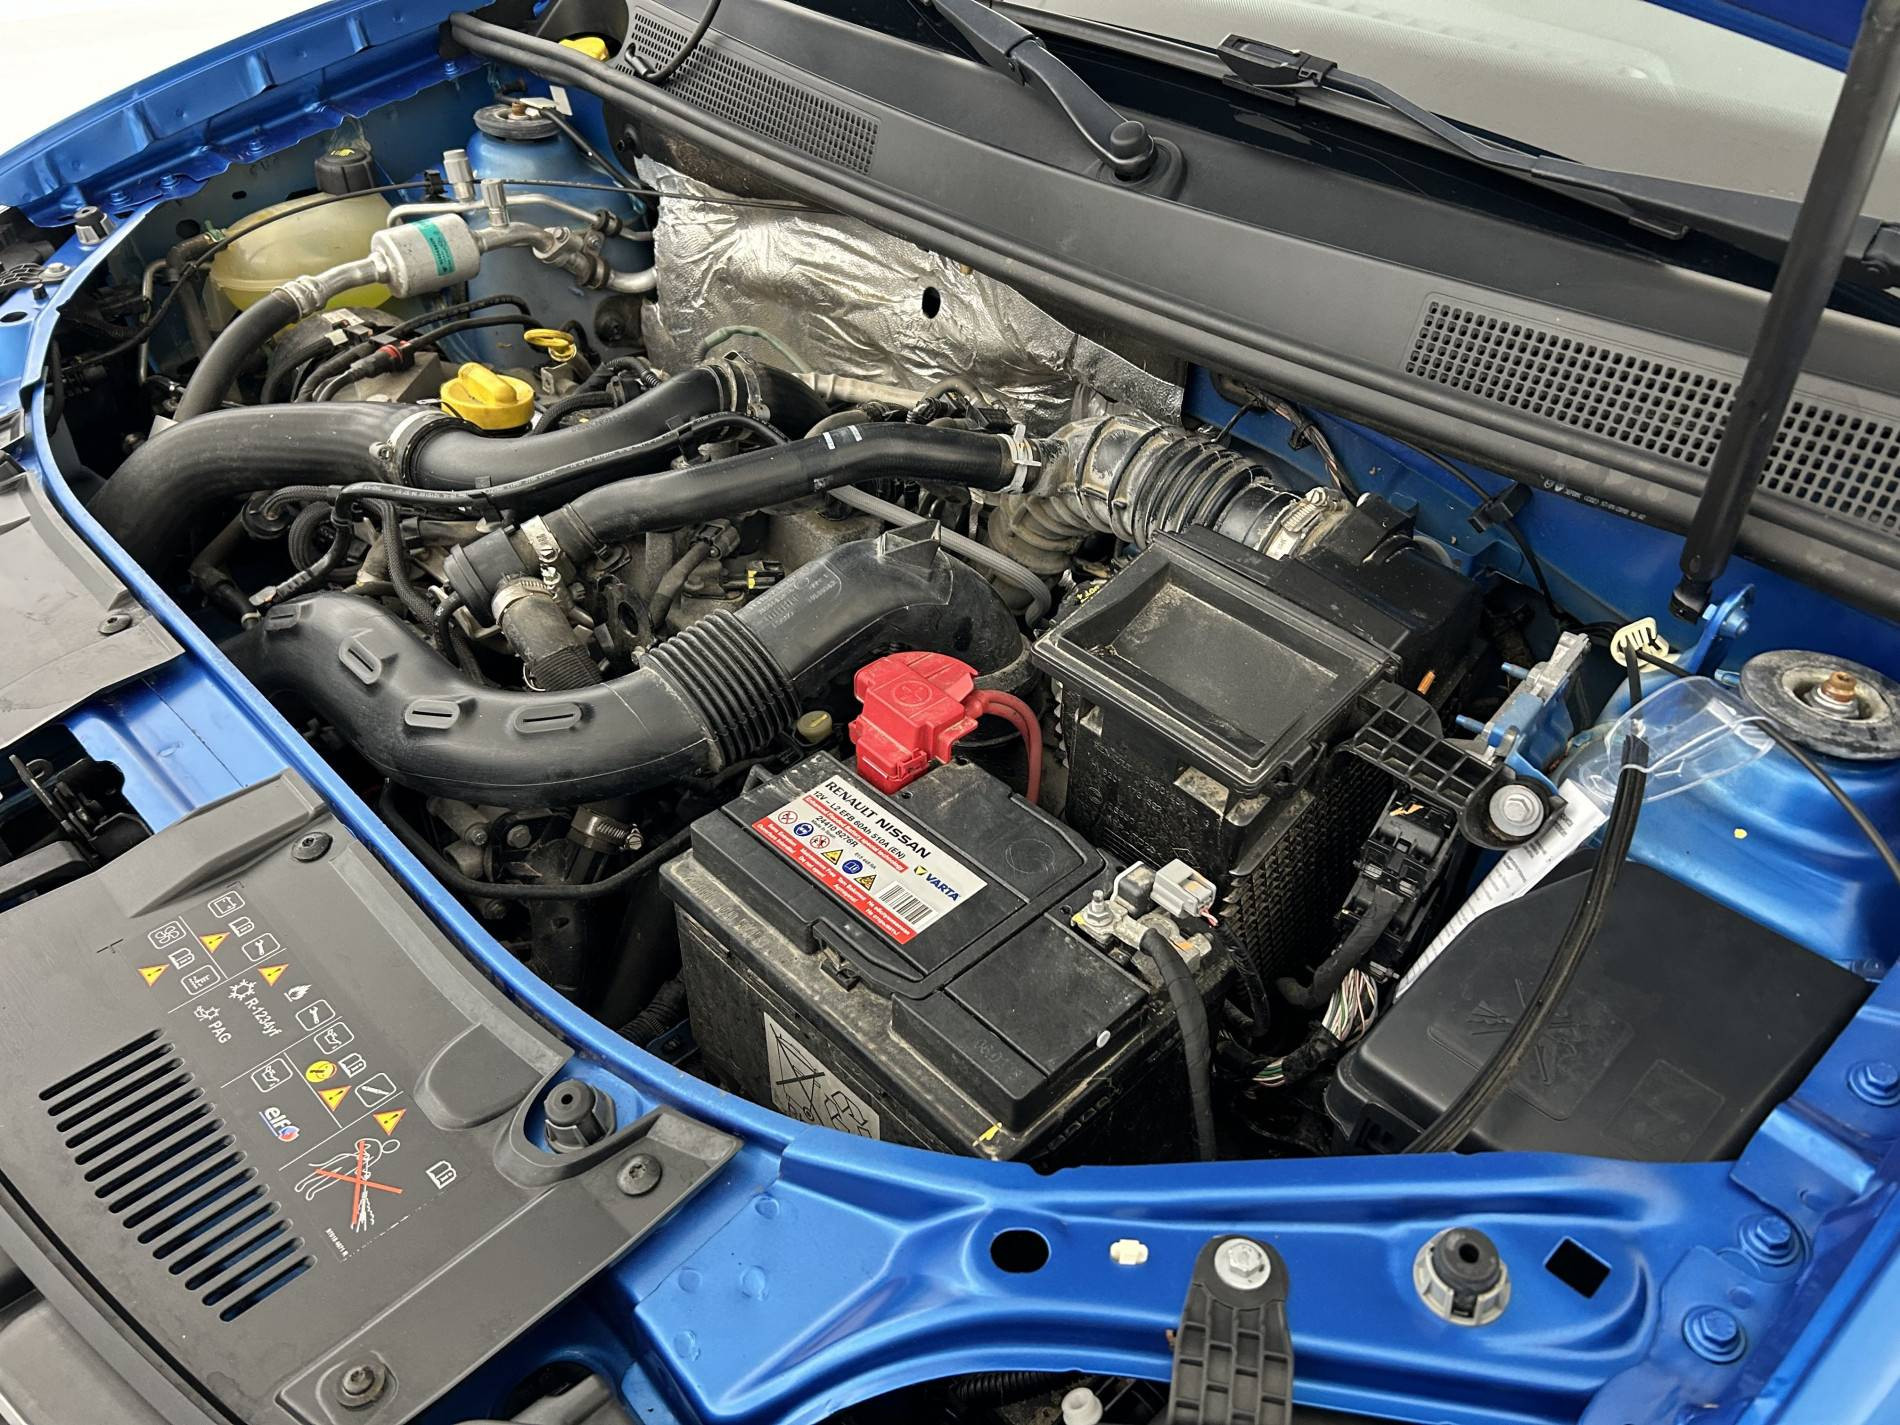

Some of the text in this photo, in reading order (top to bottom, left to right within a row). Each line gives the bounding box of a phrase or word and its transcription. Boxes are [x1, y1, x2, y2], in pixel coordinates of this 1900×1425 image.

[810, 819, 822, 827] Made
[813, 790, 827, 801] 12V
[829, 803, 841, 811] L2
[838, 809, 855, 821] EFB
[853, 820, 872, 834] 60Ah
[870, 832, 889, 846] 510A
[887, 846, 906, 859] (EN)
[815, 815, 858, 847] 24410 8276R
[825, 781, 931, 859] RENAULT NISSAN
[925, 874, 960, 900] VARTA
[208, 1019, 232, 1044] PAG
[244, 997, 282, 1037] R-1234yf
[262, 1106, 293, 1133] elf
